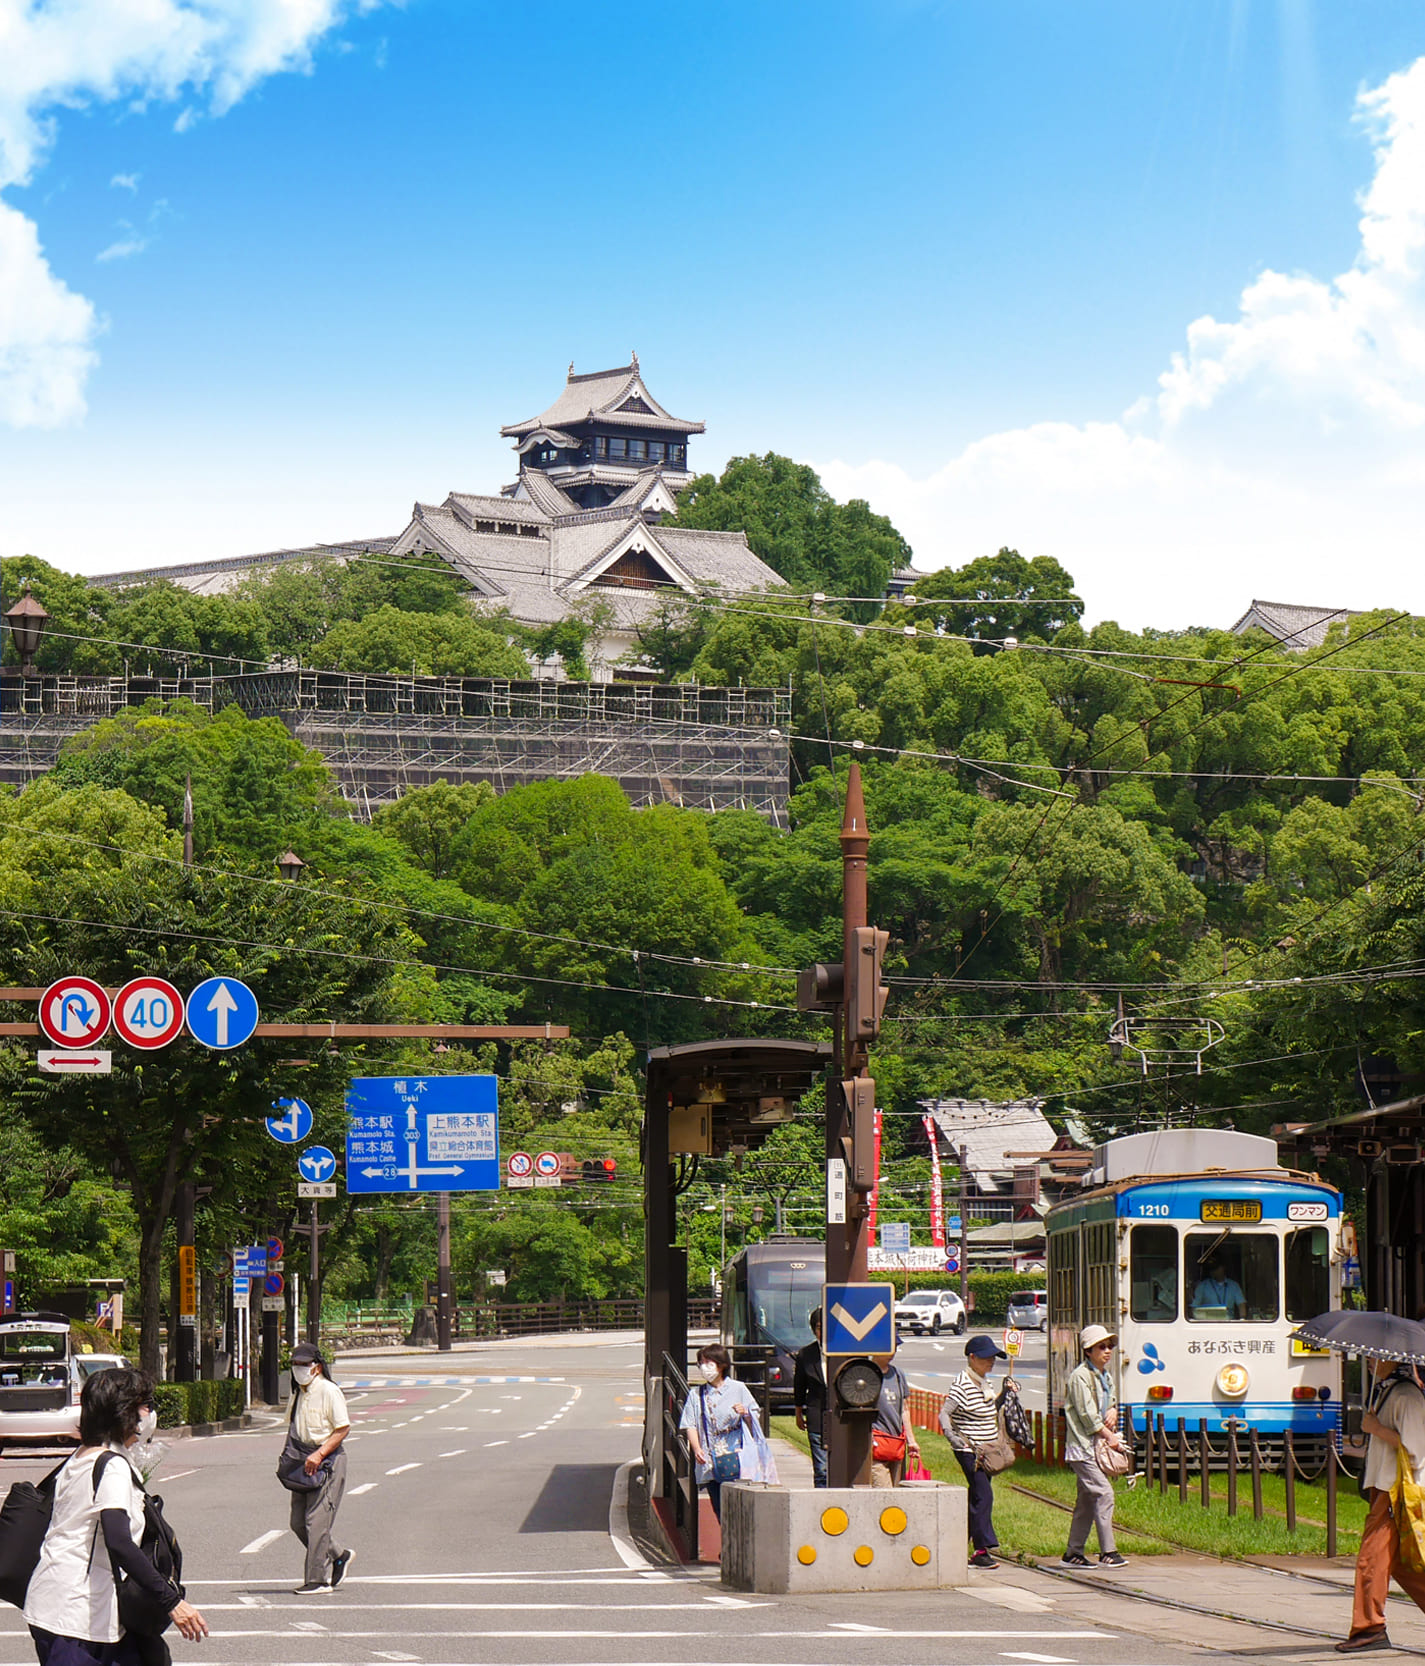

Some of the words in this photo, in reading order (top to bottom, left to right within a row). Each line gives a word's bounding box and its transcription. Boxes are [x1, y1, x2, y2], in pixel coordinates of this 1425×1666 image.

[130, 998, 168, 1028] 40
[394, 1080, 428, 1094] 植木
[350, 1115, 394, 1129] 熊本駅
[432, 1114, 490, 1129] 上熊本駅
[351, 1140, 394, 1154] 熊本城
[384, 1168, 396, 1176] 28
[1138, 1204, 1170, 1216] 1210
[1205, 1203, 1258, 1218] 交通局前
[1290, 1206, 1325, 1216] ワンマン
[1187, 1340, 1276, 1354] あなぶき興産
